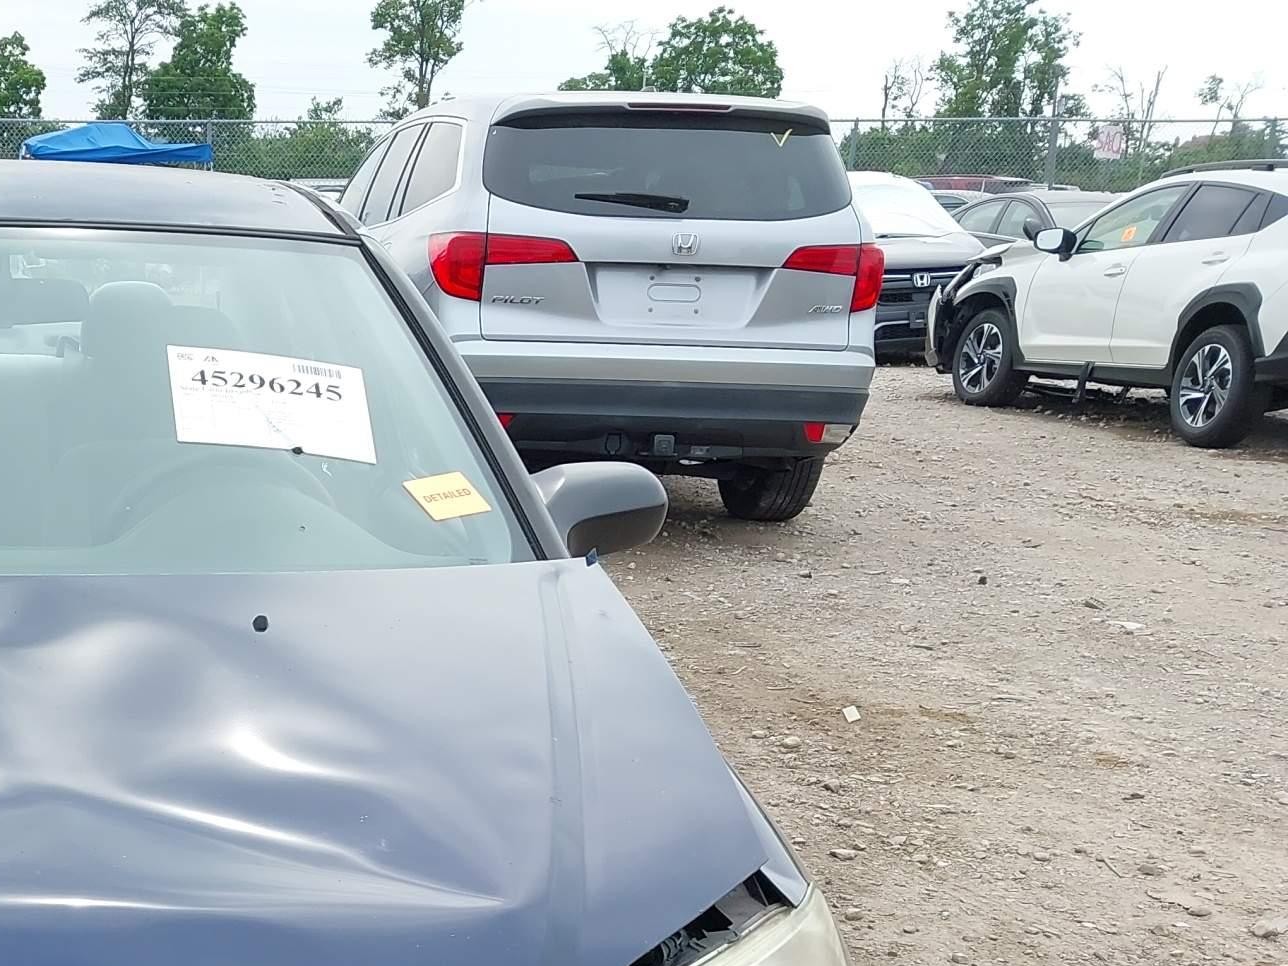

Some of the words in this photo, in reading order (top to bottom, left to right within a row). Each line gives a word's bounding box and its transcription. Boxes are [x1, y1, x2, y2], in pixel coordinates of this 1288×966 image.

[492, 295, 545, 305] PILOT
[808, 304, 843, 314] AWD
[191, 369, 343, 402] 45296245
[423, 488, 472, 504] DETAILED
